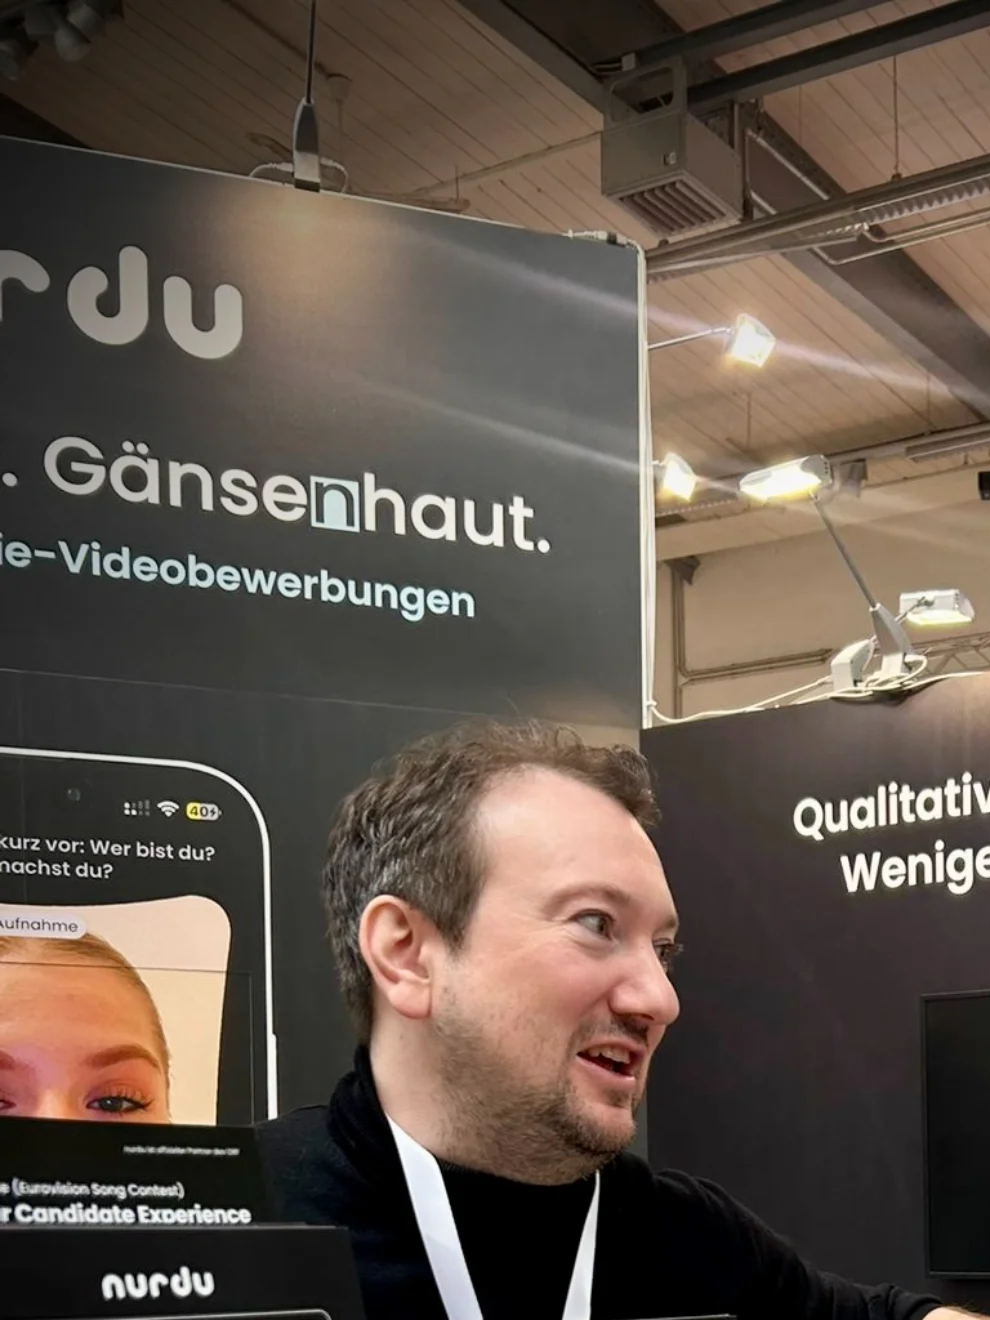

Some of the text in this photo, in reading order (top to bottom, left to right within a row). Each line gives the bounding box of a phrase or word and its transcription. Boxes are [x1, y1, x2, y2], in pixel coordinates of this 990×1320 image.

[45, 838, 84, 854] vor:
[89, 840, 131, 857] Wer
[136, 841, 173, 860] bist
[178, 844, 215, 862] du?
[76, 862, 113, 879] du?
[91, 1183, 127, 1199] Song
[128, 1182, 185, 1199] Contest)
[14, 1202, 135, 1224] Candidate
[137, 1203, 252, 1223] Experience
[101, 1266, 215, 1299] nurdu
